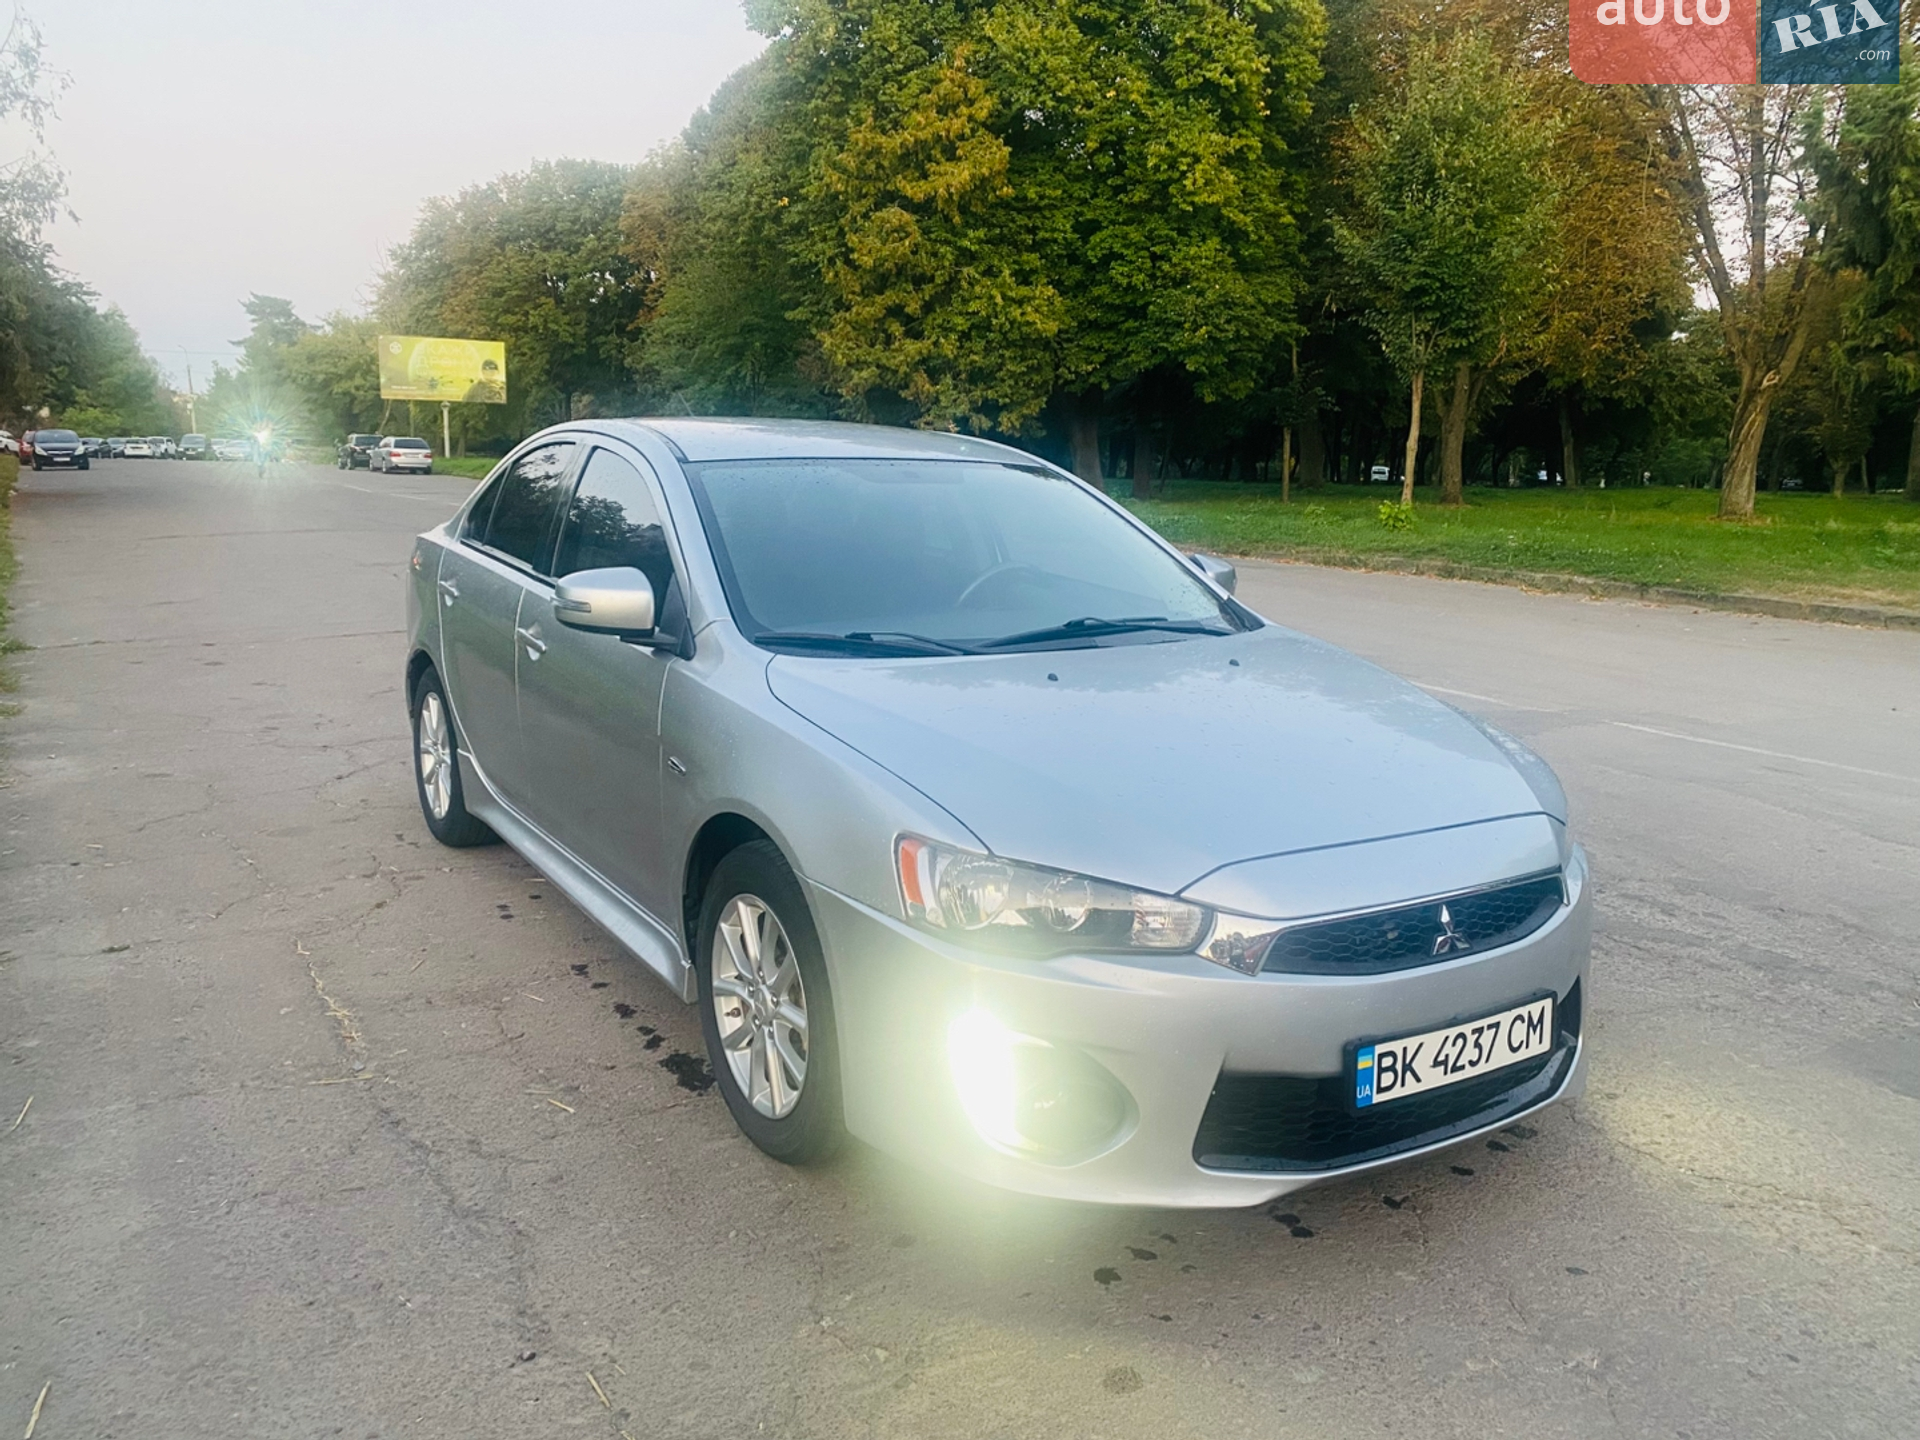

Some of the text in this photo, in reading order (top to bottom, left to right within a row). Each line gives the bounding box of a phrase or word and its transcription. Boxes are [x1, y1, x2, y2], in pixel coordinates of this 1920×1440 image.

[1376, 1005, 1545, 1095] BK 4237 CM
[1356, 1086, 1371, 1099] UA
